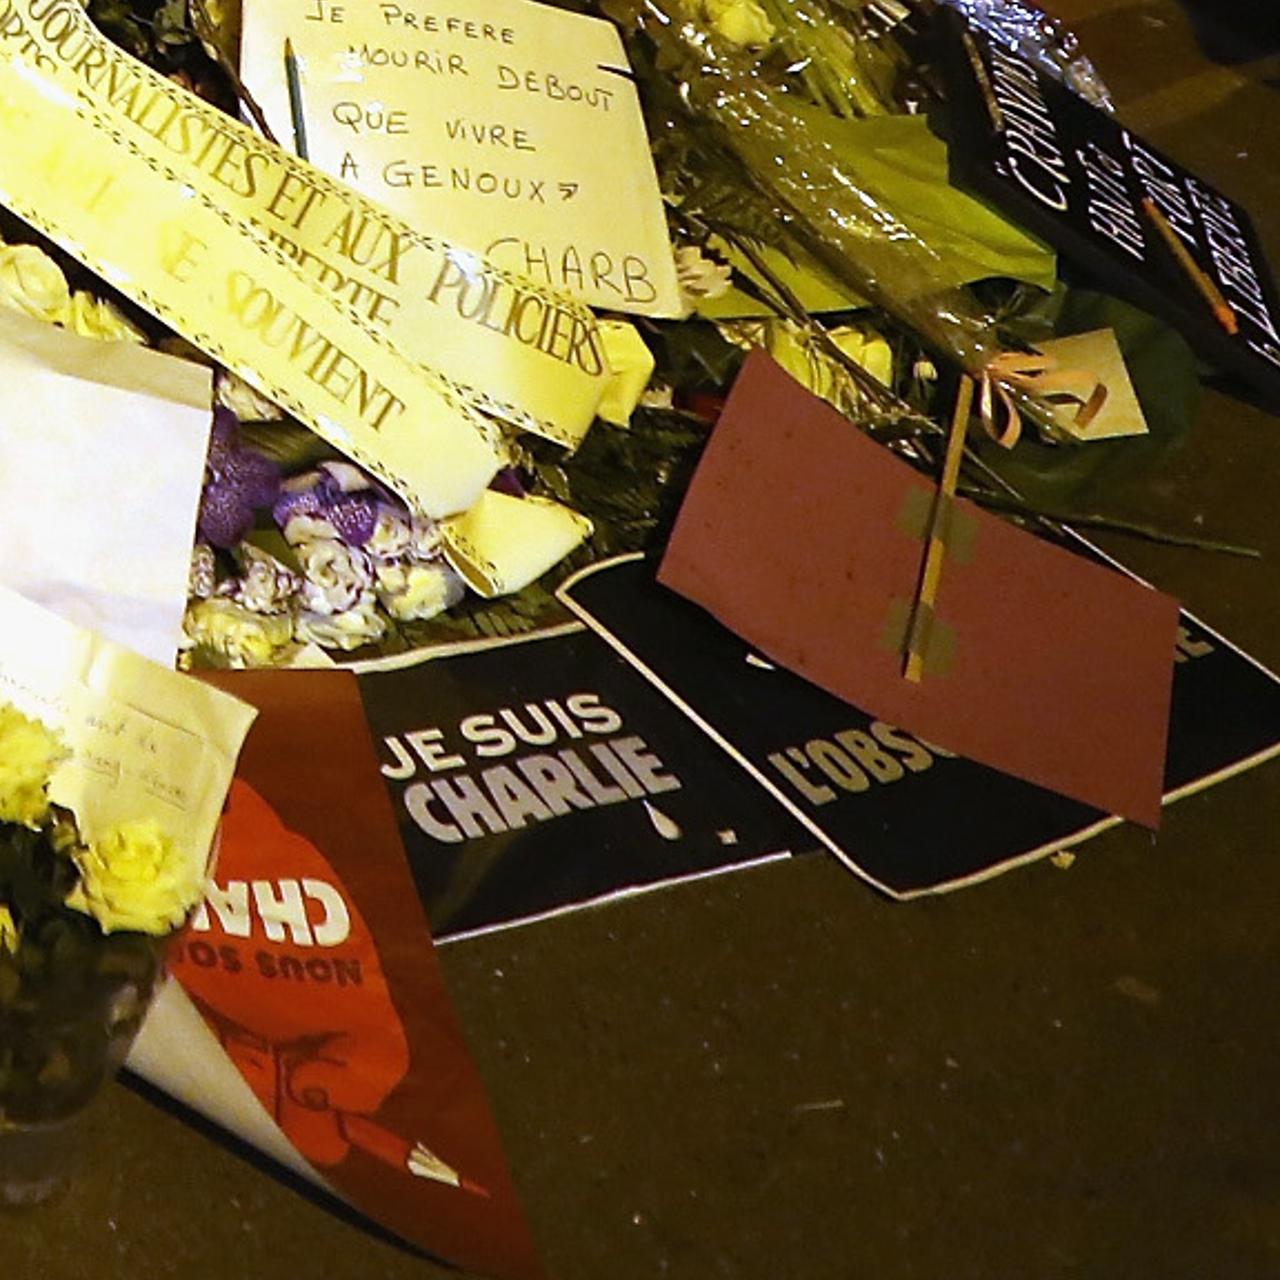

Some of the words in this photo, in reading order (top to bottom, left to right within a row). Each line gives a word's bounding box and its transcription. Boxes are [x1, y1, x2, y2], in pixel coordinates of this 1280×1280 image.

[379, 2, 518, 46] PREFERE
[498, 66, 615, 112] DEBOUT
[333, 101, 409, 135] QUE
[340, 152, 359, 180] A
[266, 171, 327, 231] ET
[321, 200, 418, 288] AUX
[427, 253, 604, 378] POLICIERS
[485, 238, 657, 303] CHARB
[226, 269, 408, 436] SOUVIENT
[381, 728, 467, 780] JE
[460, 694, 624, 757] SUIS
[403, 735, 682, 843] CHARLIE
[255, 948, 362, 987] NOUS
